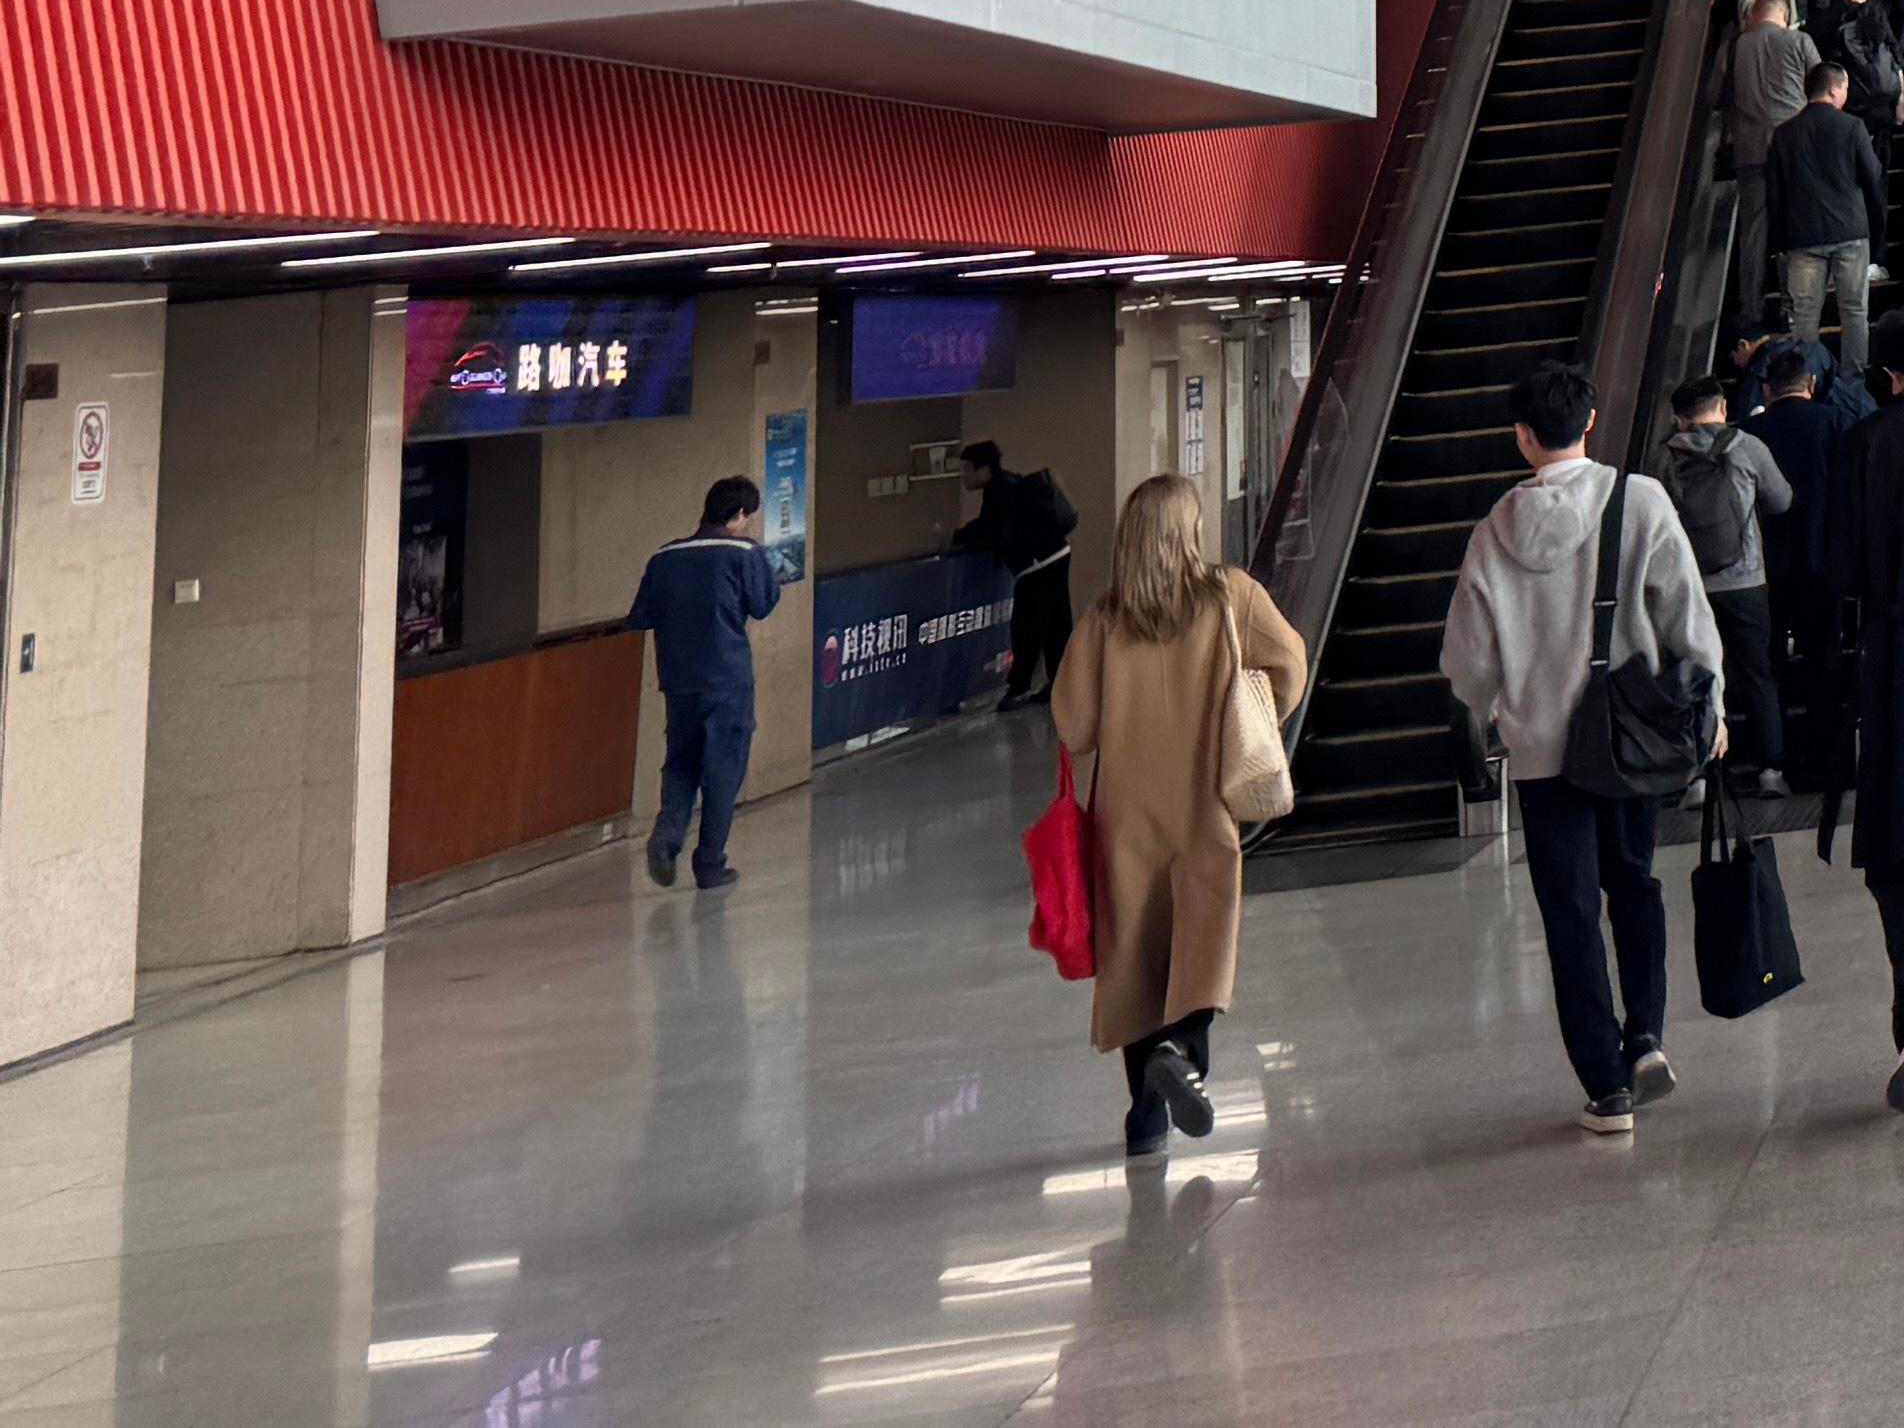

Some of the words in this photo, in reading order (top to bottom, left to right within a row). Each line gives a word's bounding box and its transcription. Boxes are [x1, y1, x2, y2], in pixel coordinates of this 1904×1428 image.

[517, 339, 628, 392] 路咖汽车
[841, 613, 909, 665] 科技视讯
